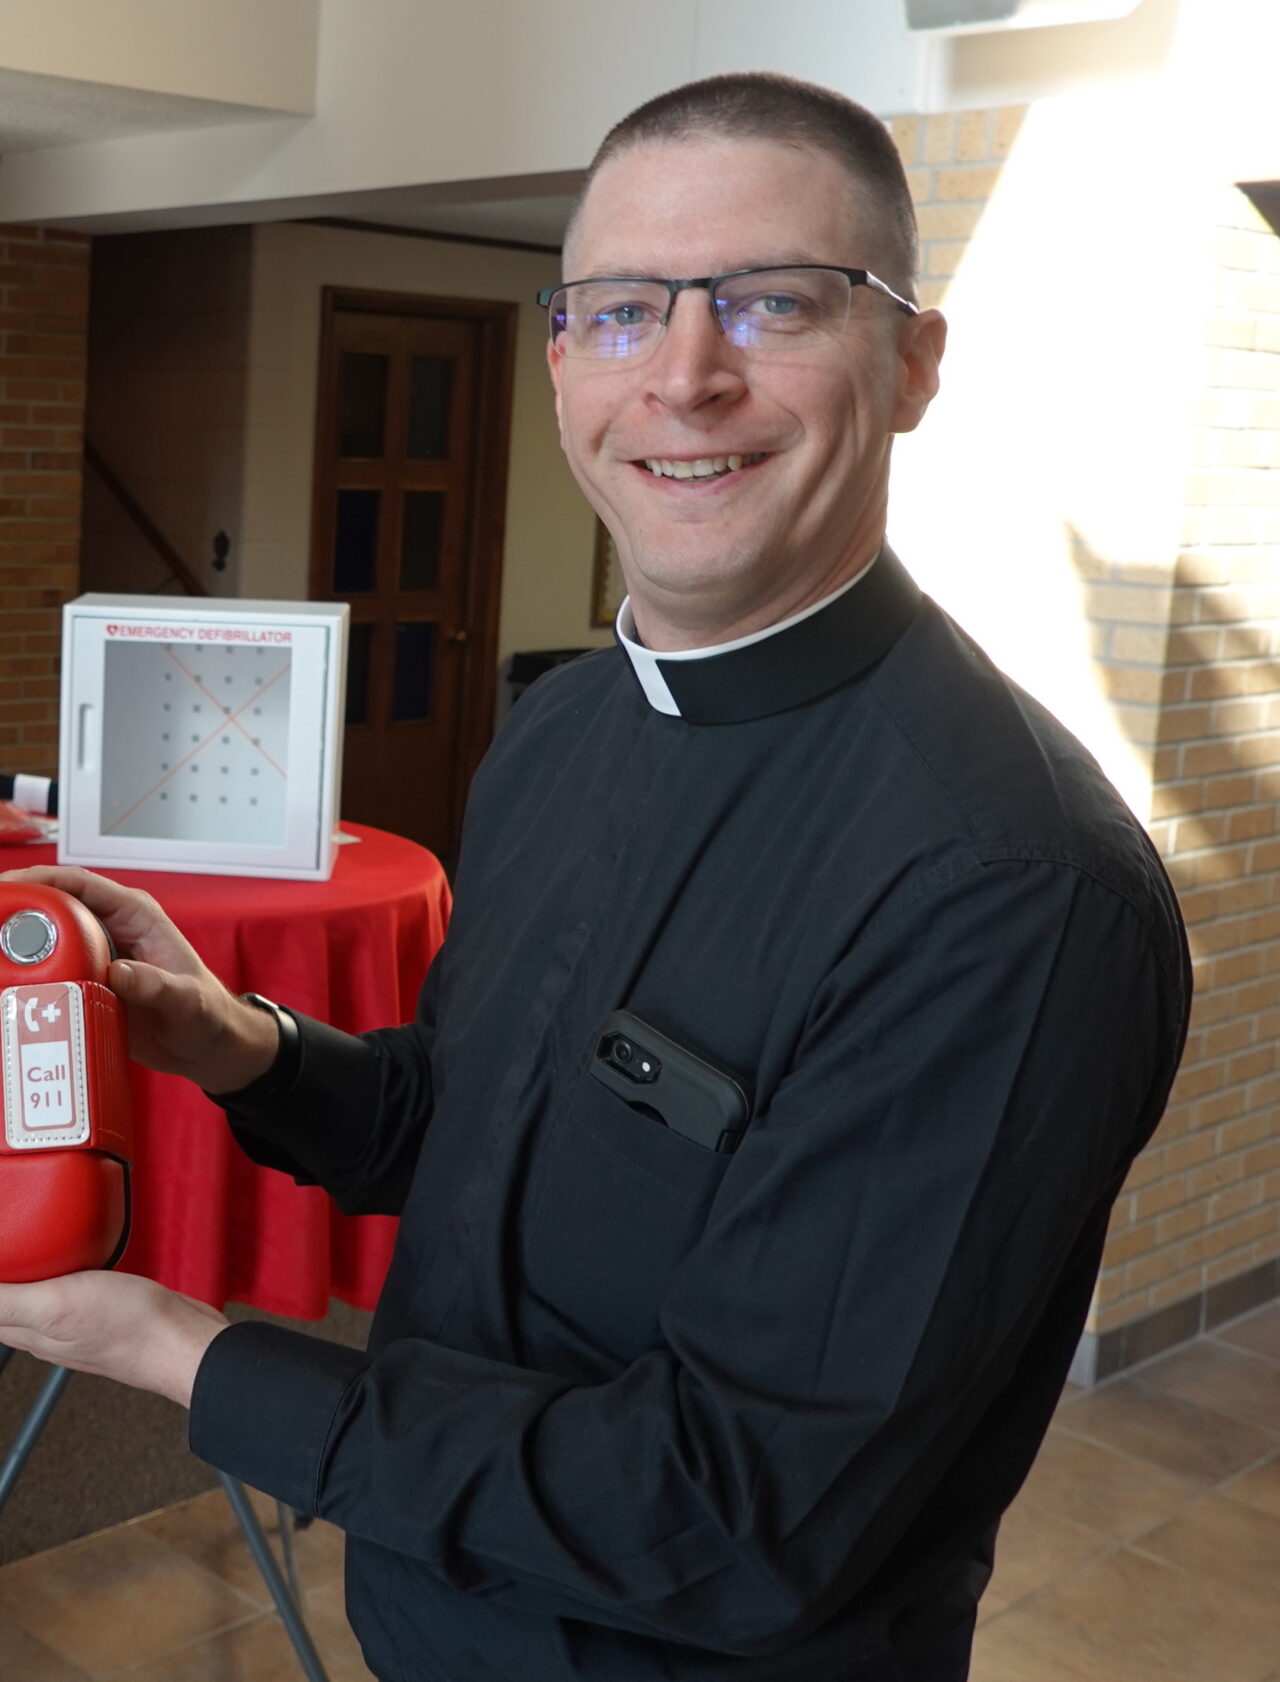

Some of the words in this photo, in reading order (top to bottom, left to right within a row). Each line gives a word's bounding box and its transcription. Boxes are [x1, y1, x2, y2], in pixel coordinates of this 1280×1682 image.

[120, 625, 195, 640] EMERGENCY
[198, 629, 292, 643] DEFIBRILLATOR
[27, 1064, 66, 1082] Call
[30, 1090, 62, 1109] 911
